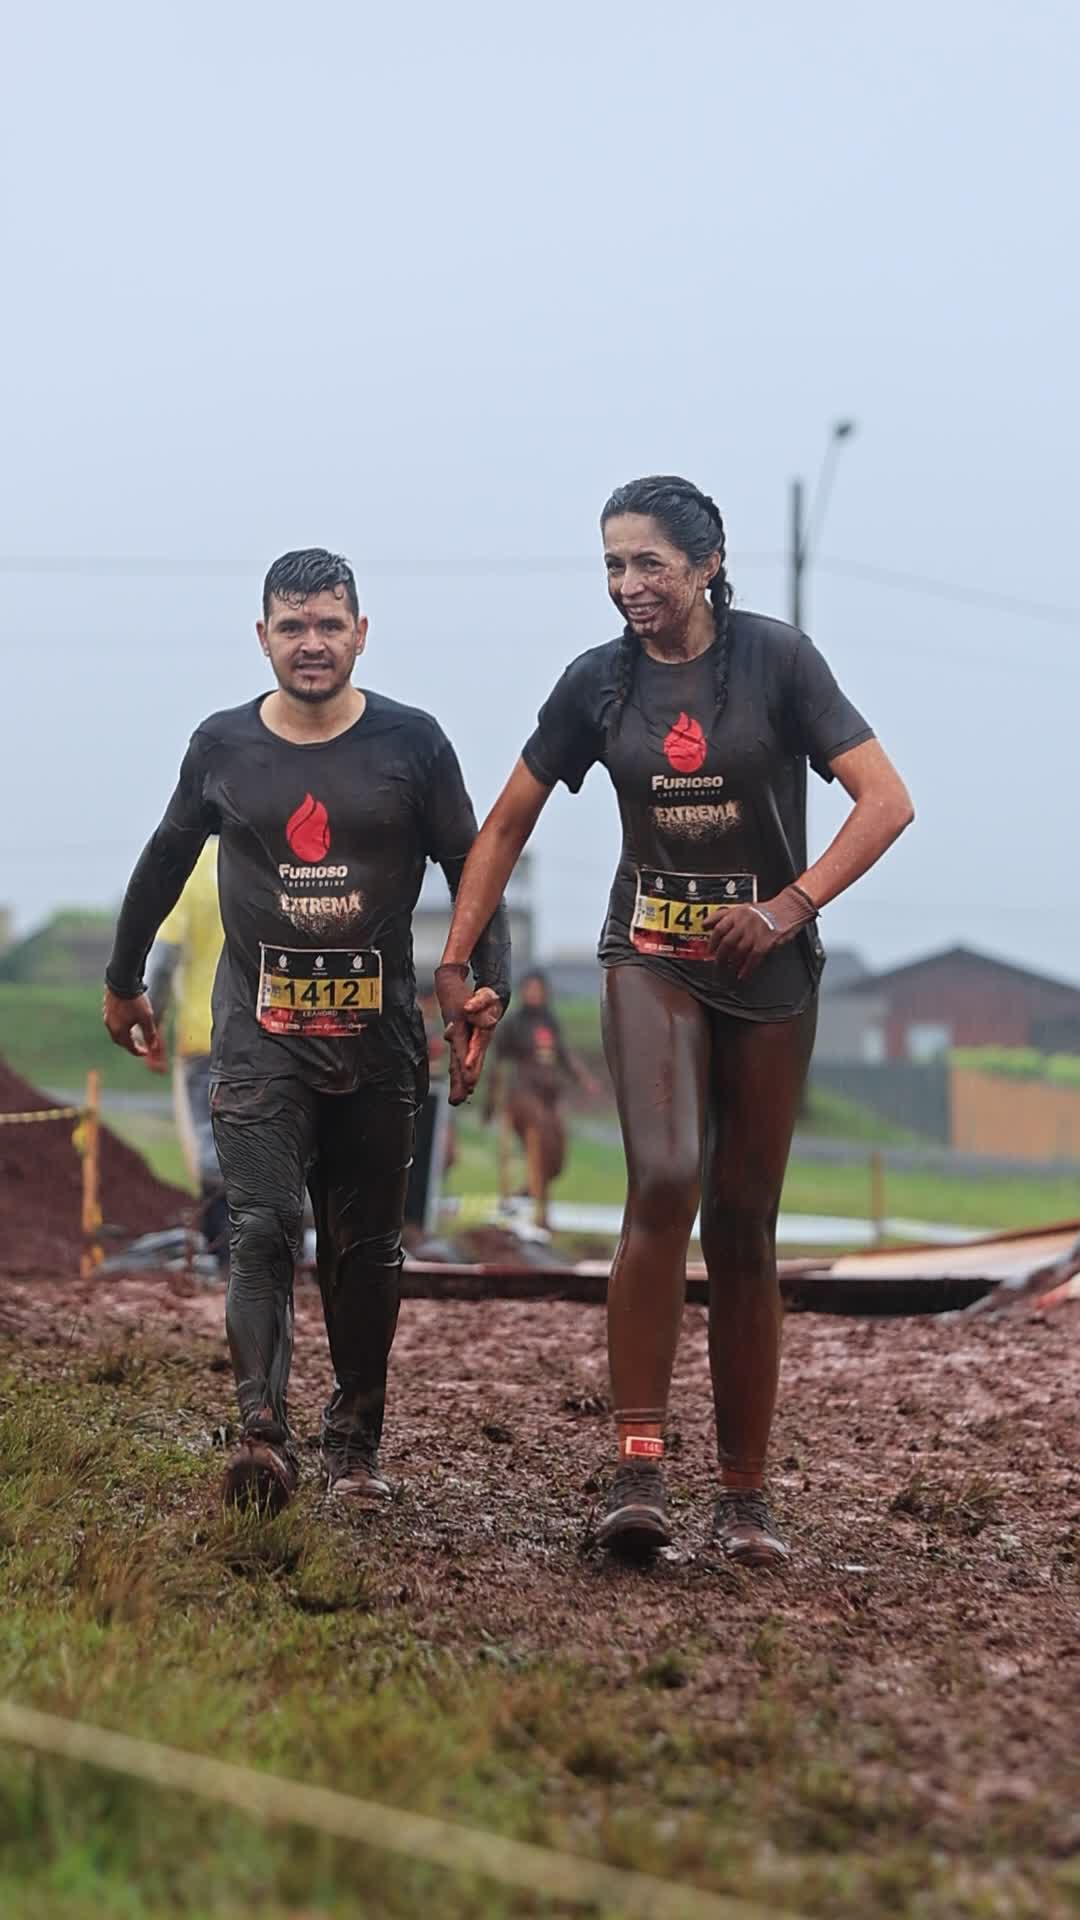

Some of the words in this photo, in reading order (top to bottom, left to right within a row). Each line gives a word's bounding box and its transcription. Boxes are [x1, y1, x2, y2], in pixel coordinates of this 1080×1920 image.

[652, 775, 724, 791] FURIOSO
[654, 801, 738, 823] EXTREMA
[278, 863, 349, 879] FURIOSO
[280, 890, 363, 916] EXTREMA
[658, 902, 729, 931] 141
[284, 980, 360, 1008] 1412
